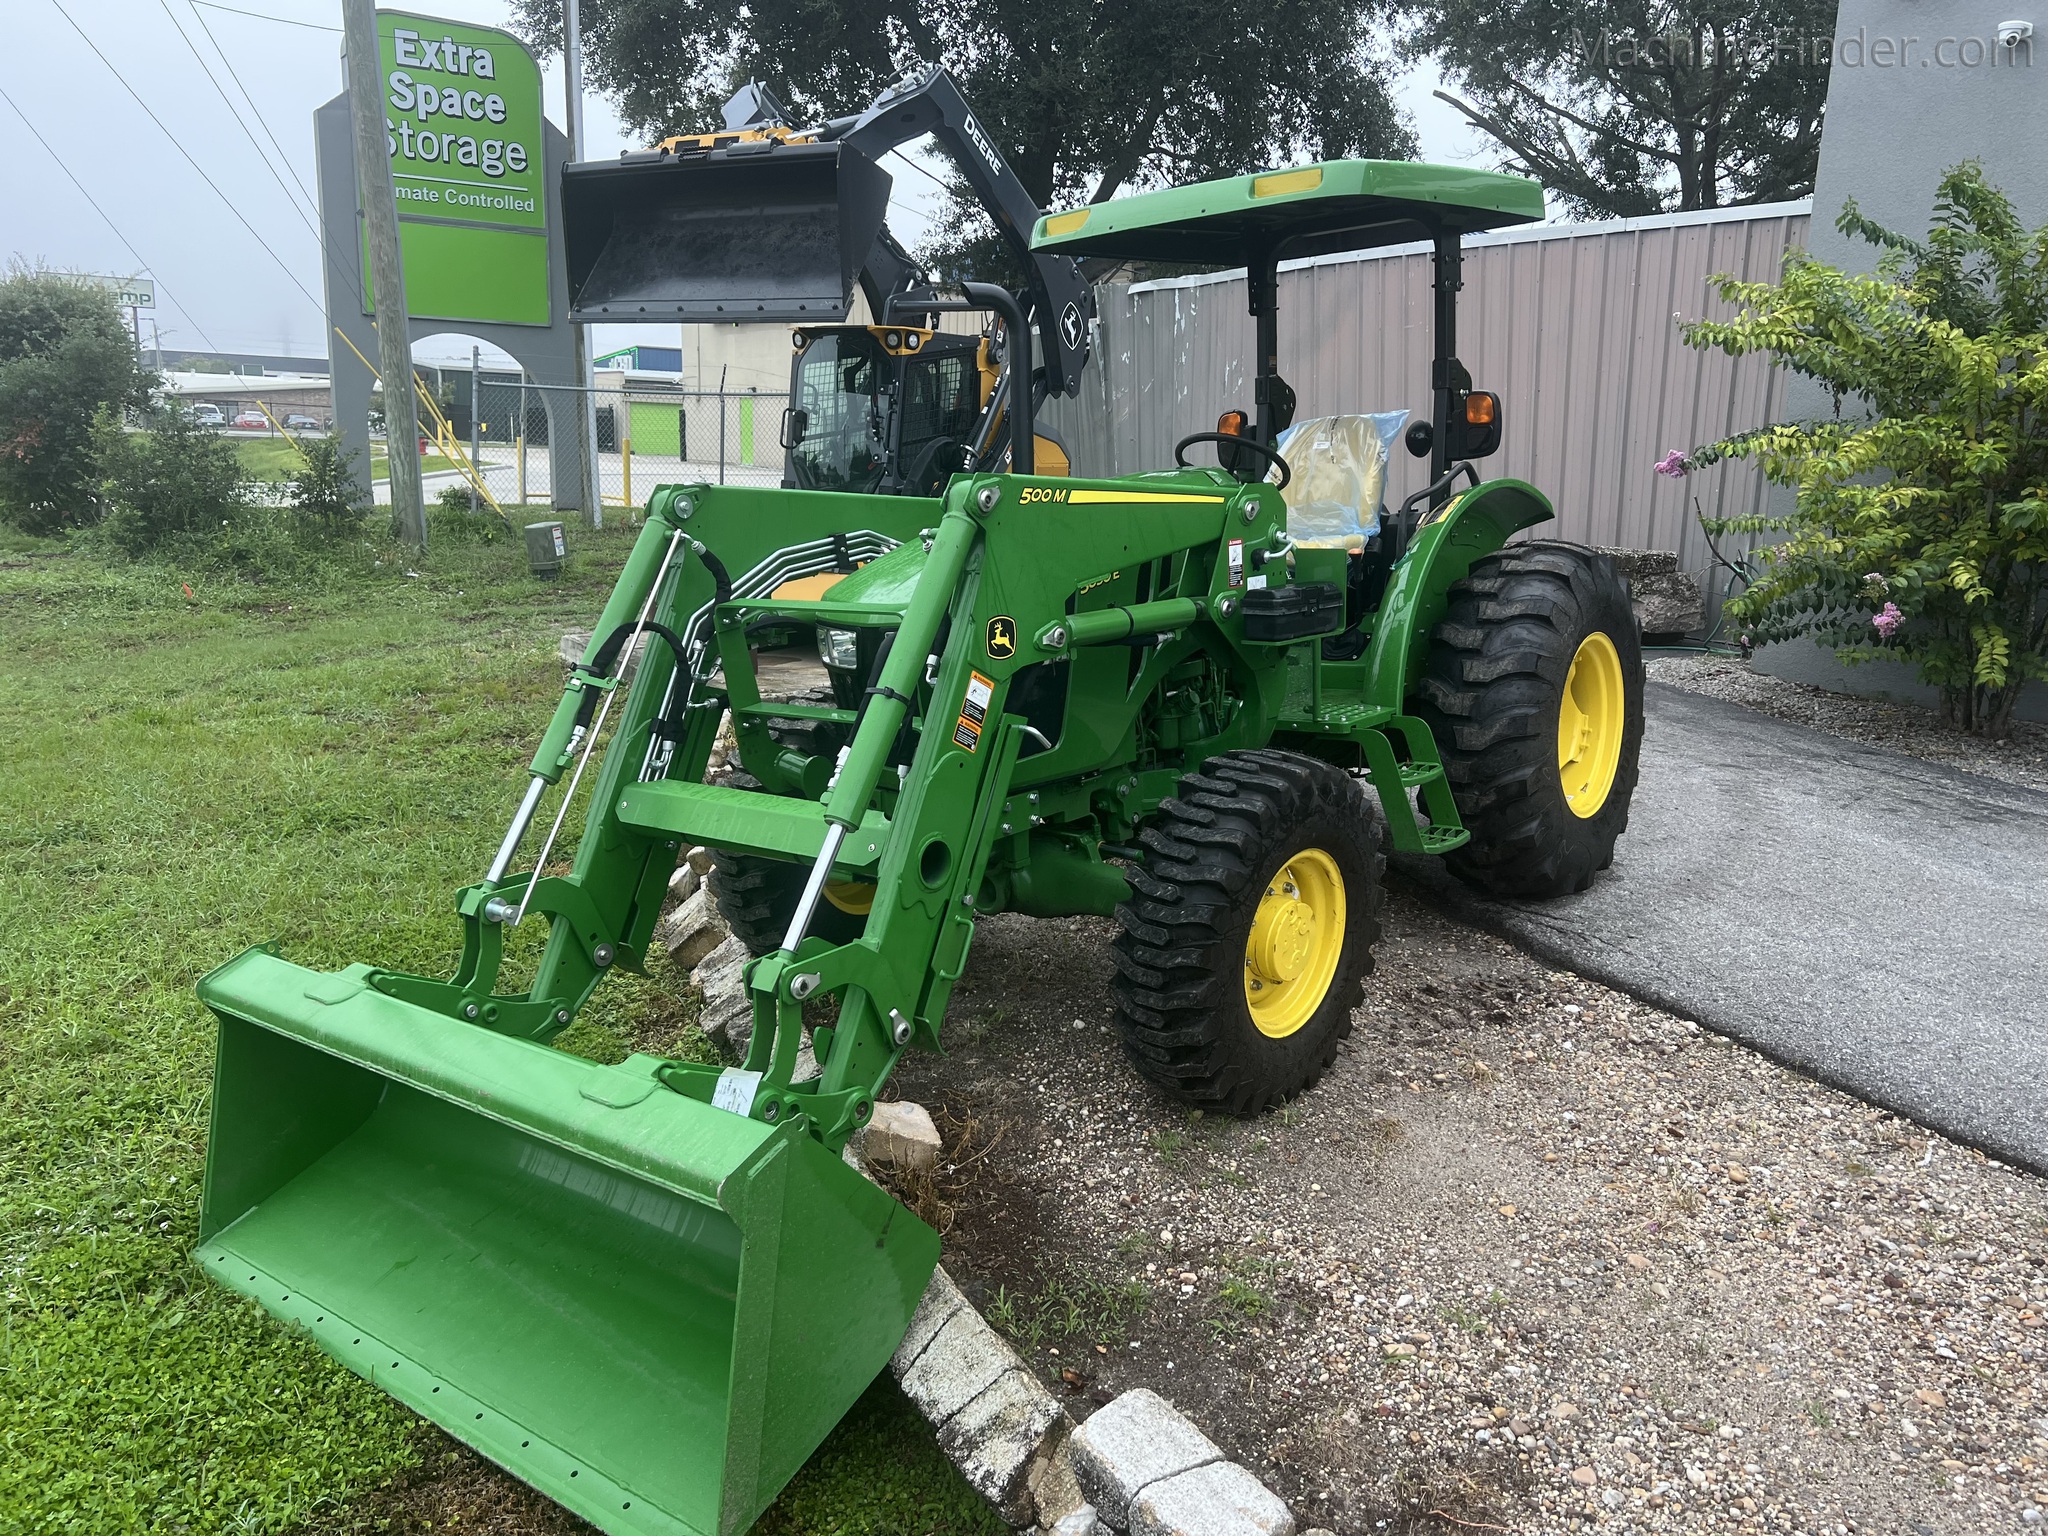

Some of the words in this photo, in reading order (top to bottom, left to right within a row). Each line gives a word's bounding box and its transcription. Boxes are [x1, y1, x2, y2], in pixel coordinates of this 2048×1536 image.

[394, 29, 495, 79] Extra
[389, 71, 506, 123] Space
[964, 113, 1002, 176] DEERE
[396, 185, 439, 202] mate
[445, 188, 534, 212] Controlled
[109, 291, 151, 305] emp
